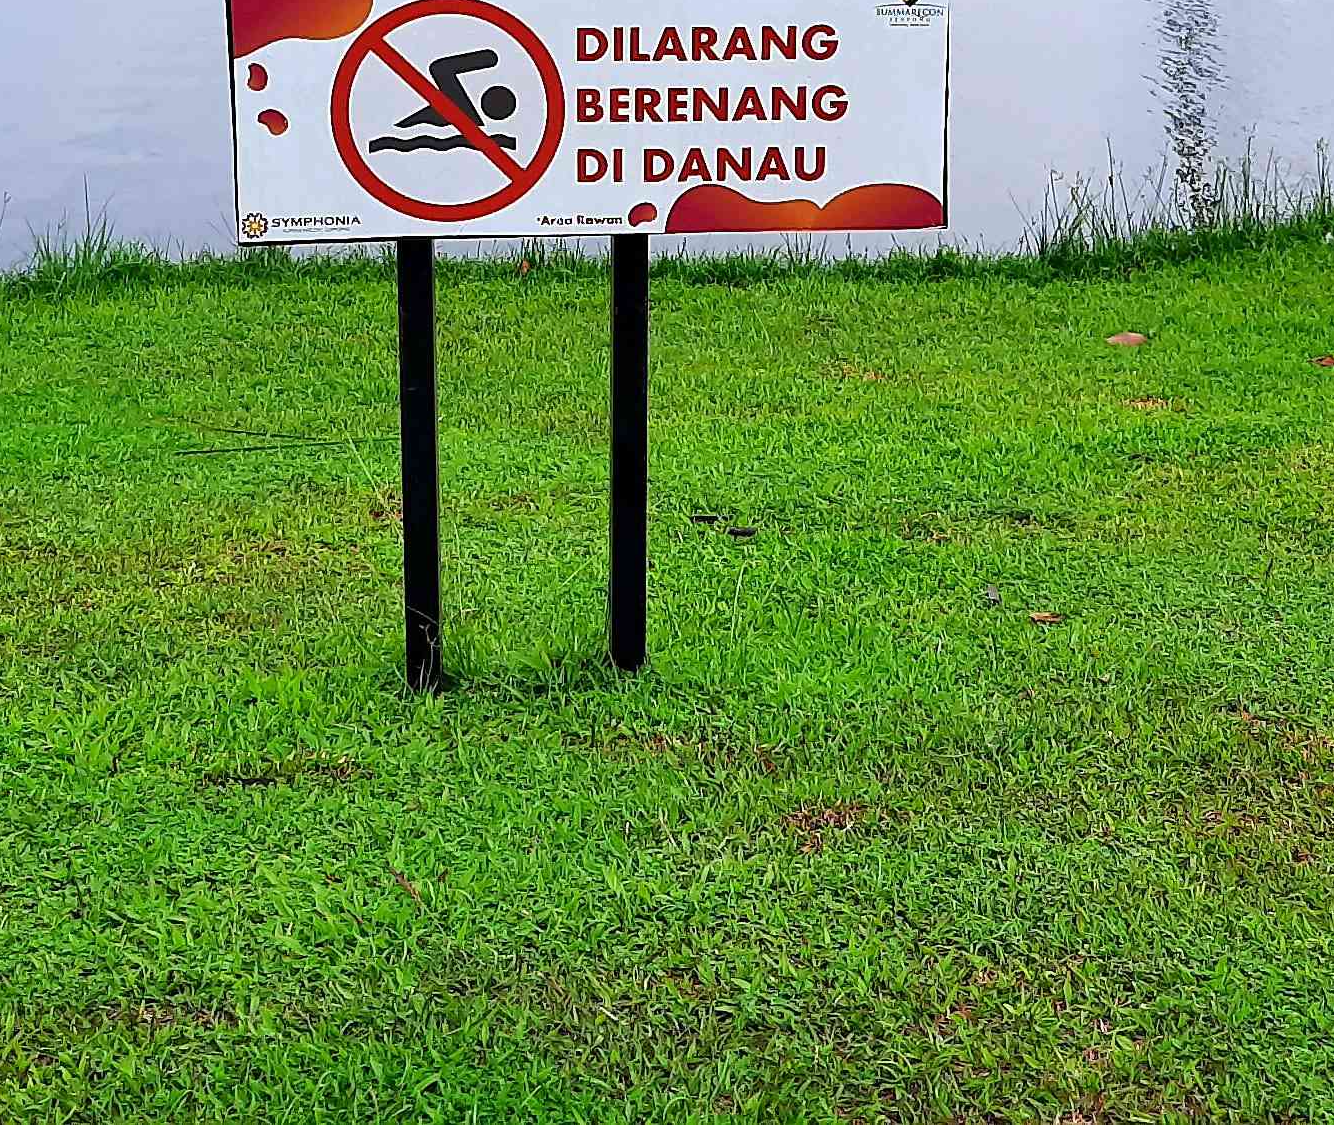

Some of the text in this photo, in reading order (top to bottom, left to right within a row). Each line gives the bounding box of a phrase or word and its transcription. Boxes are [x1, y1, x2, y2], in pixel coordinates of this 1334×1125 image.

[575, 24, 839, 62] DILARANG
[575, 85, 848, 124] BERENANG
[576, 146, 827, 184] DI DANAU
[271, 215, 362, 228] SYMPHONIA
